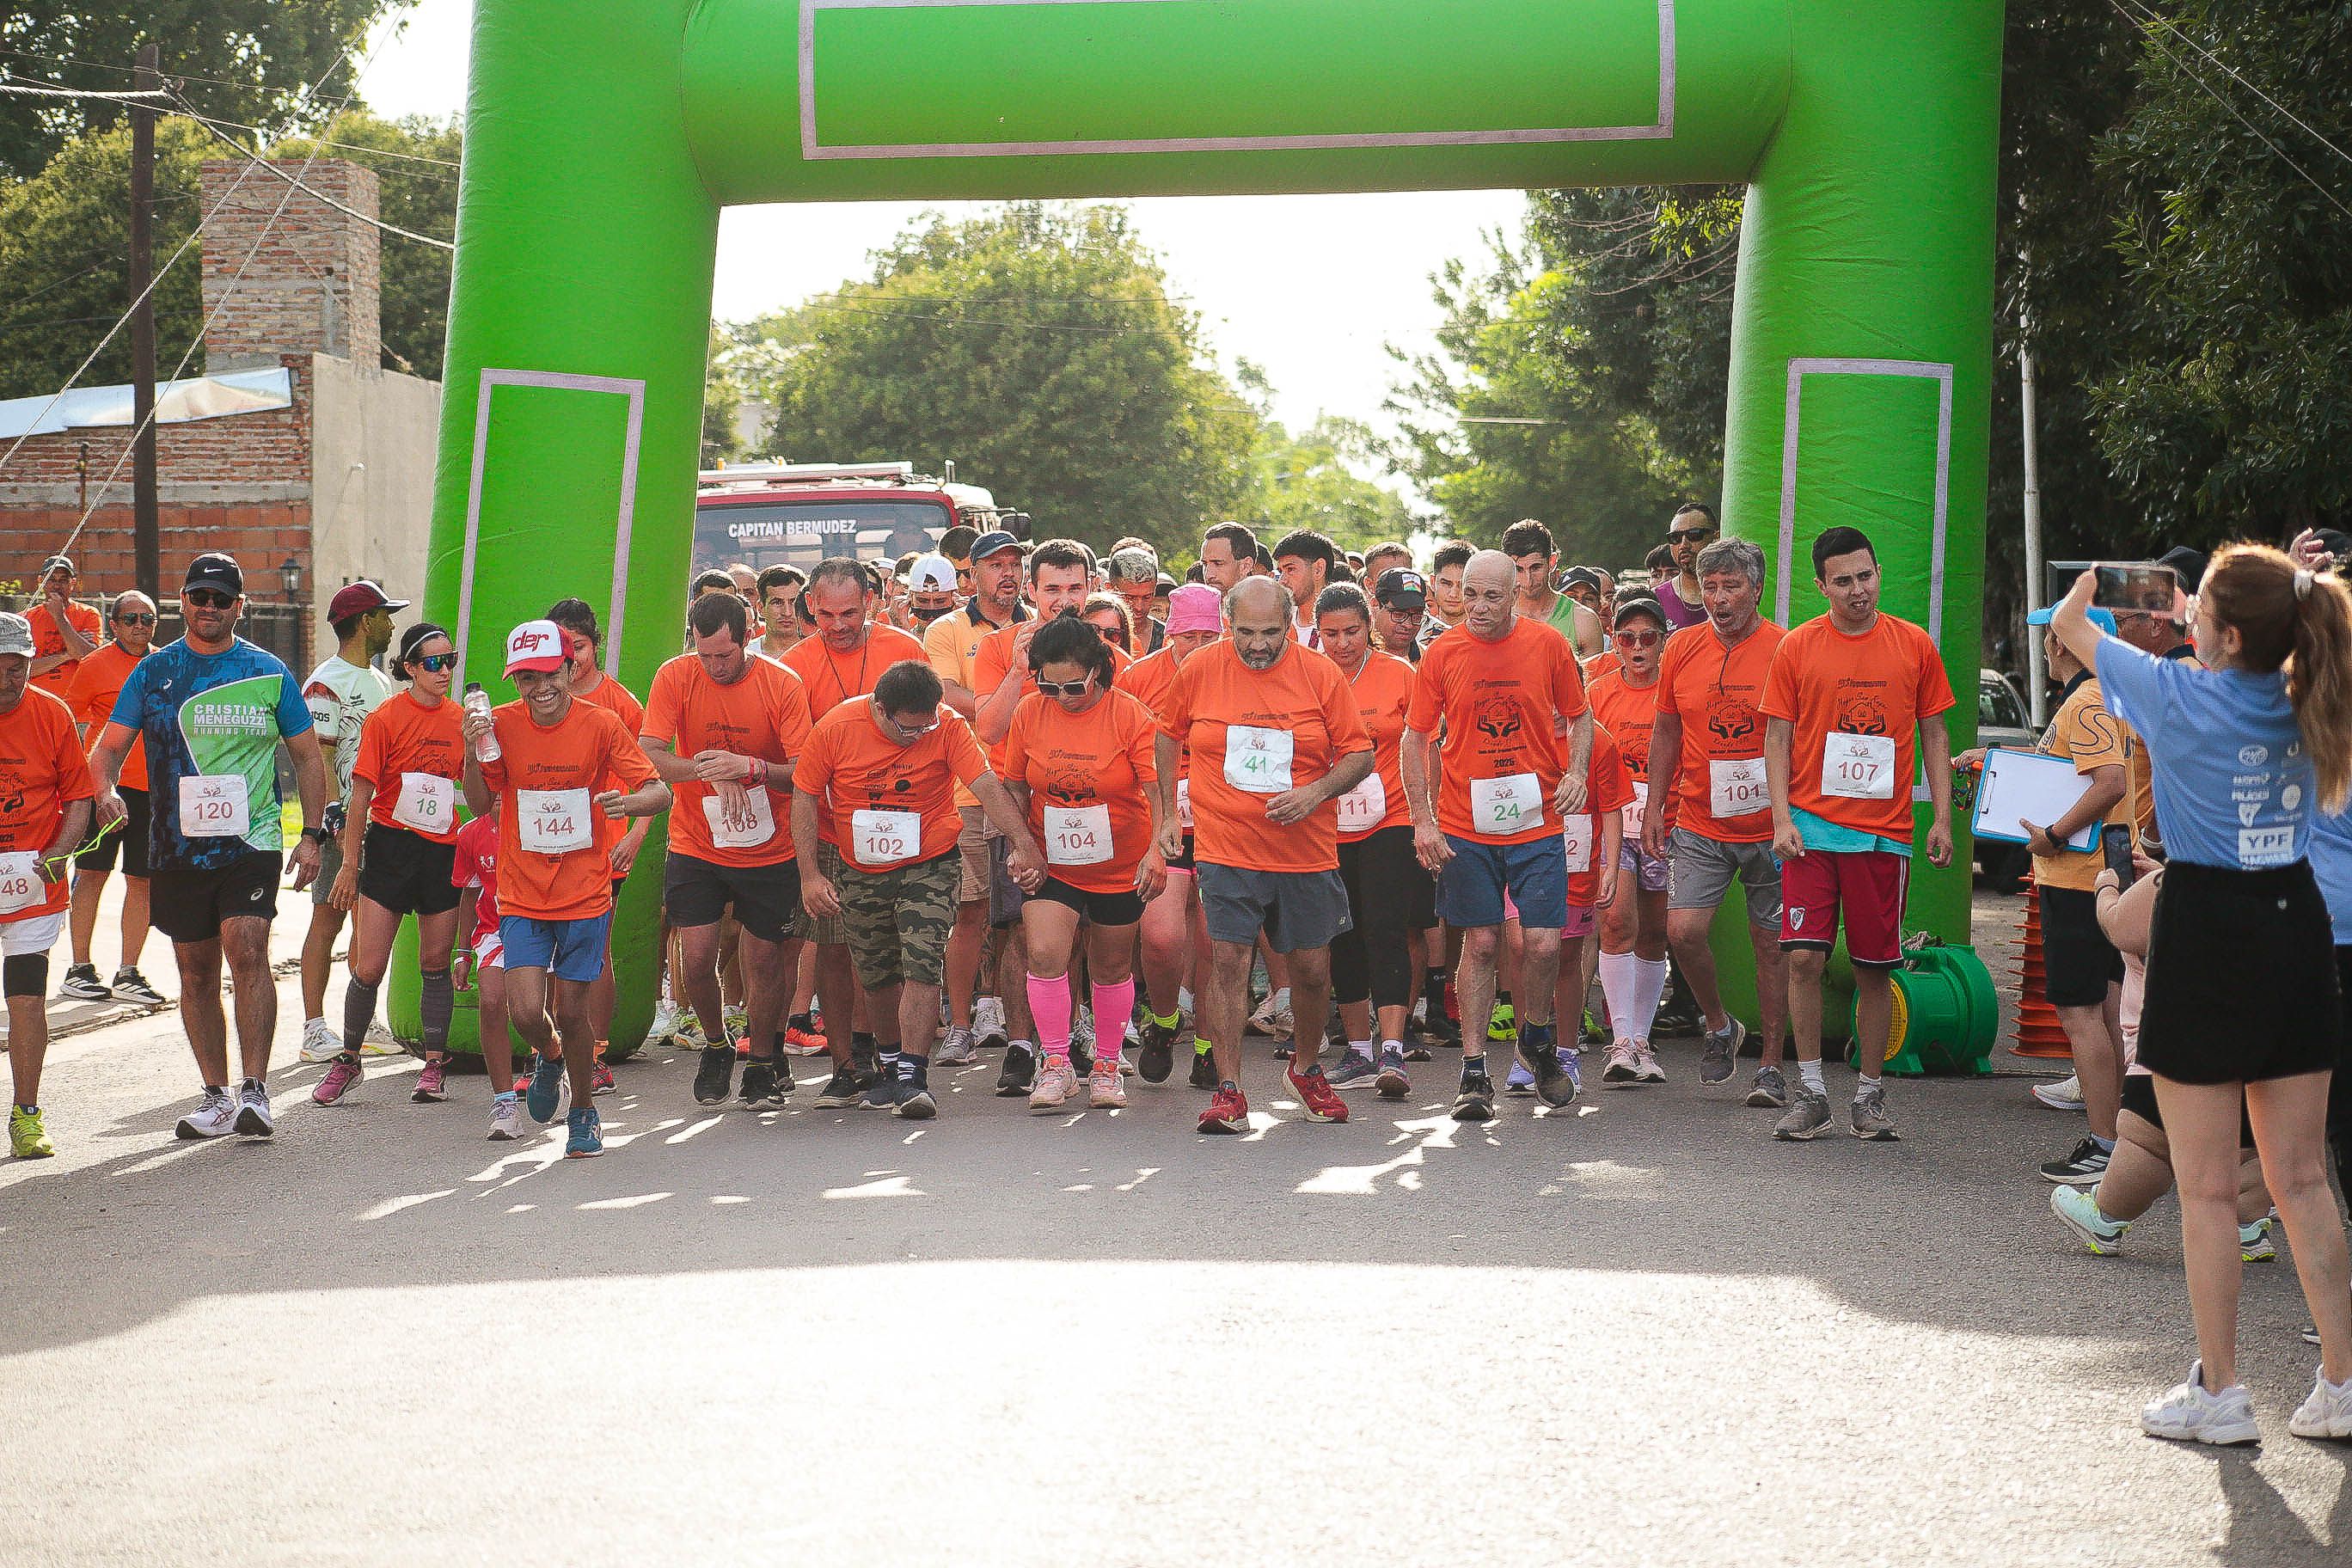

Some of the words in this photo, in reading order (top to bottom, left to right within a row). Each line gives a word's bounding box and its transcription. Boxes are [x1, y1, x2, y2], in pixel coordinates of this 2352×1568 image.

[729, 523, 784, 537] CAPITAN
[787, 519, 857, 535] BERMUDEZ
[513, 630, 549, 652] der
[194, 705, 268, 715] CRISTIAN
[1245, 756, 1266, 774] 41
[1839, 762, 1878, 781] 107
[1724, 784, 1760, 801] 101
[194, 801, 233, 819] 120
[417, 798, 437, 816] 18
[1494, 803, 1520, 821] 24
[533, 816, 574, 836] 144
[867, 837, 903, 855] 102
[1058, 831, 1096, 849] 104
[2246, 834, 2288, 848] YPF
